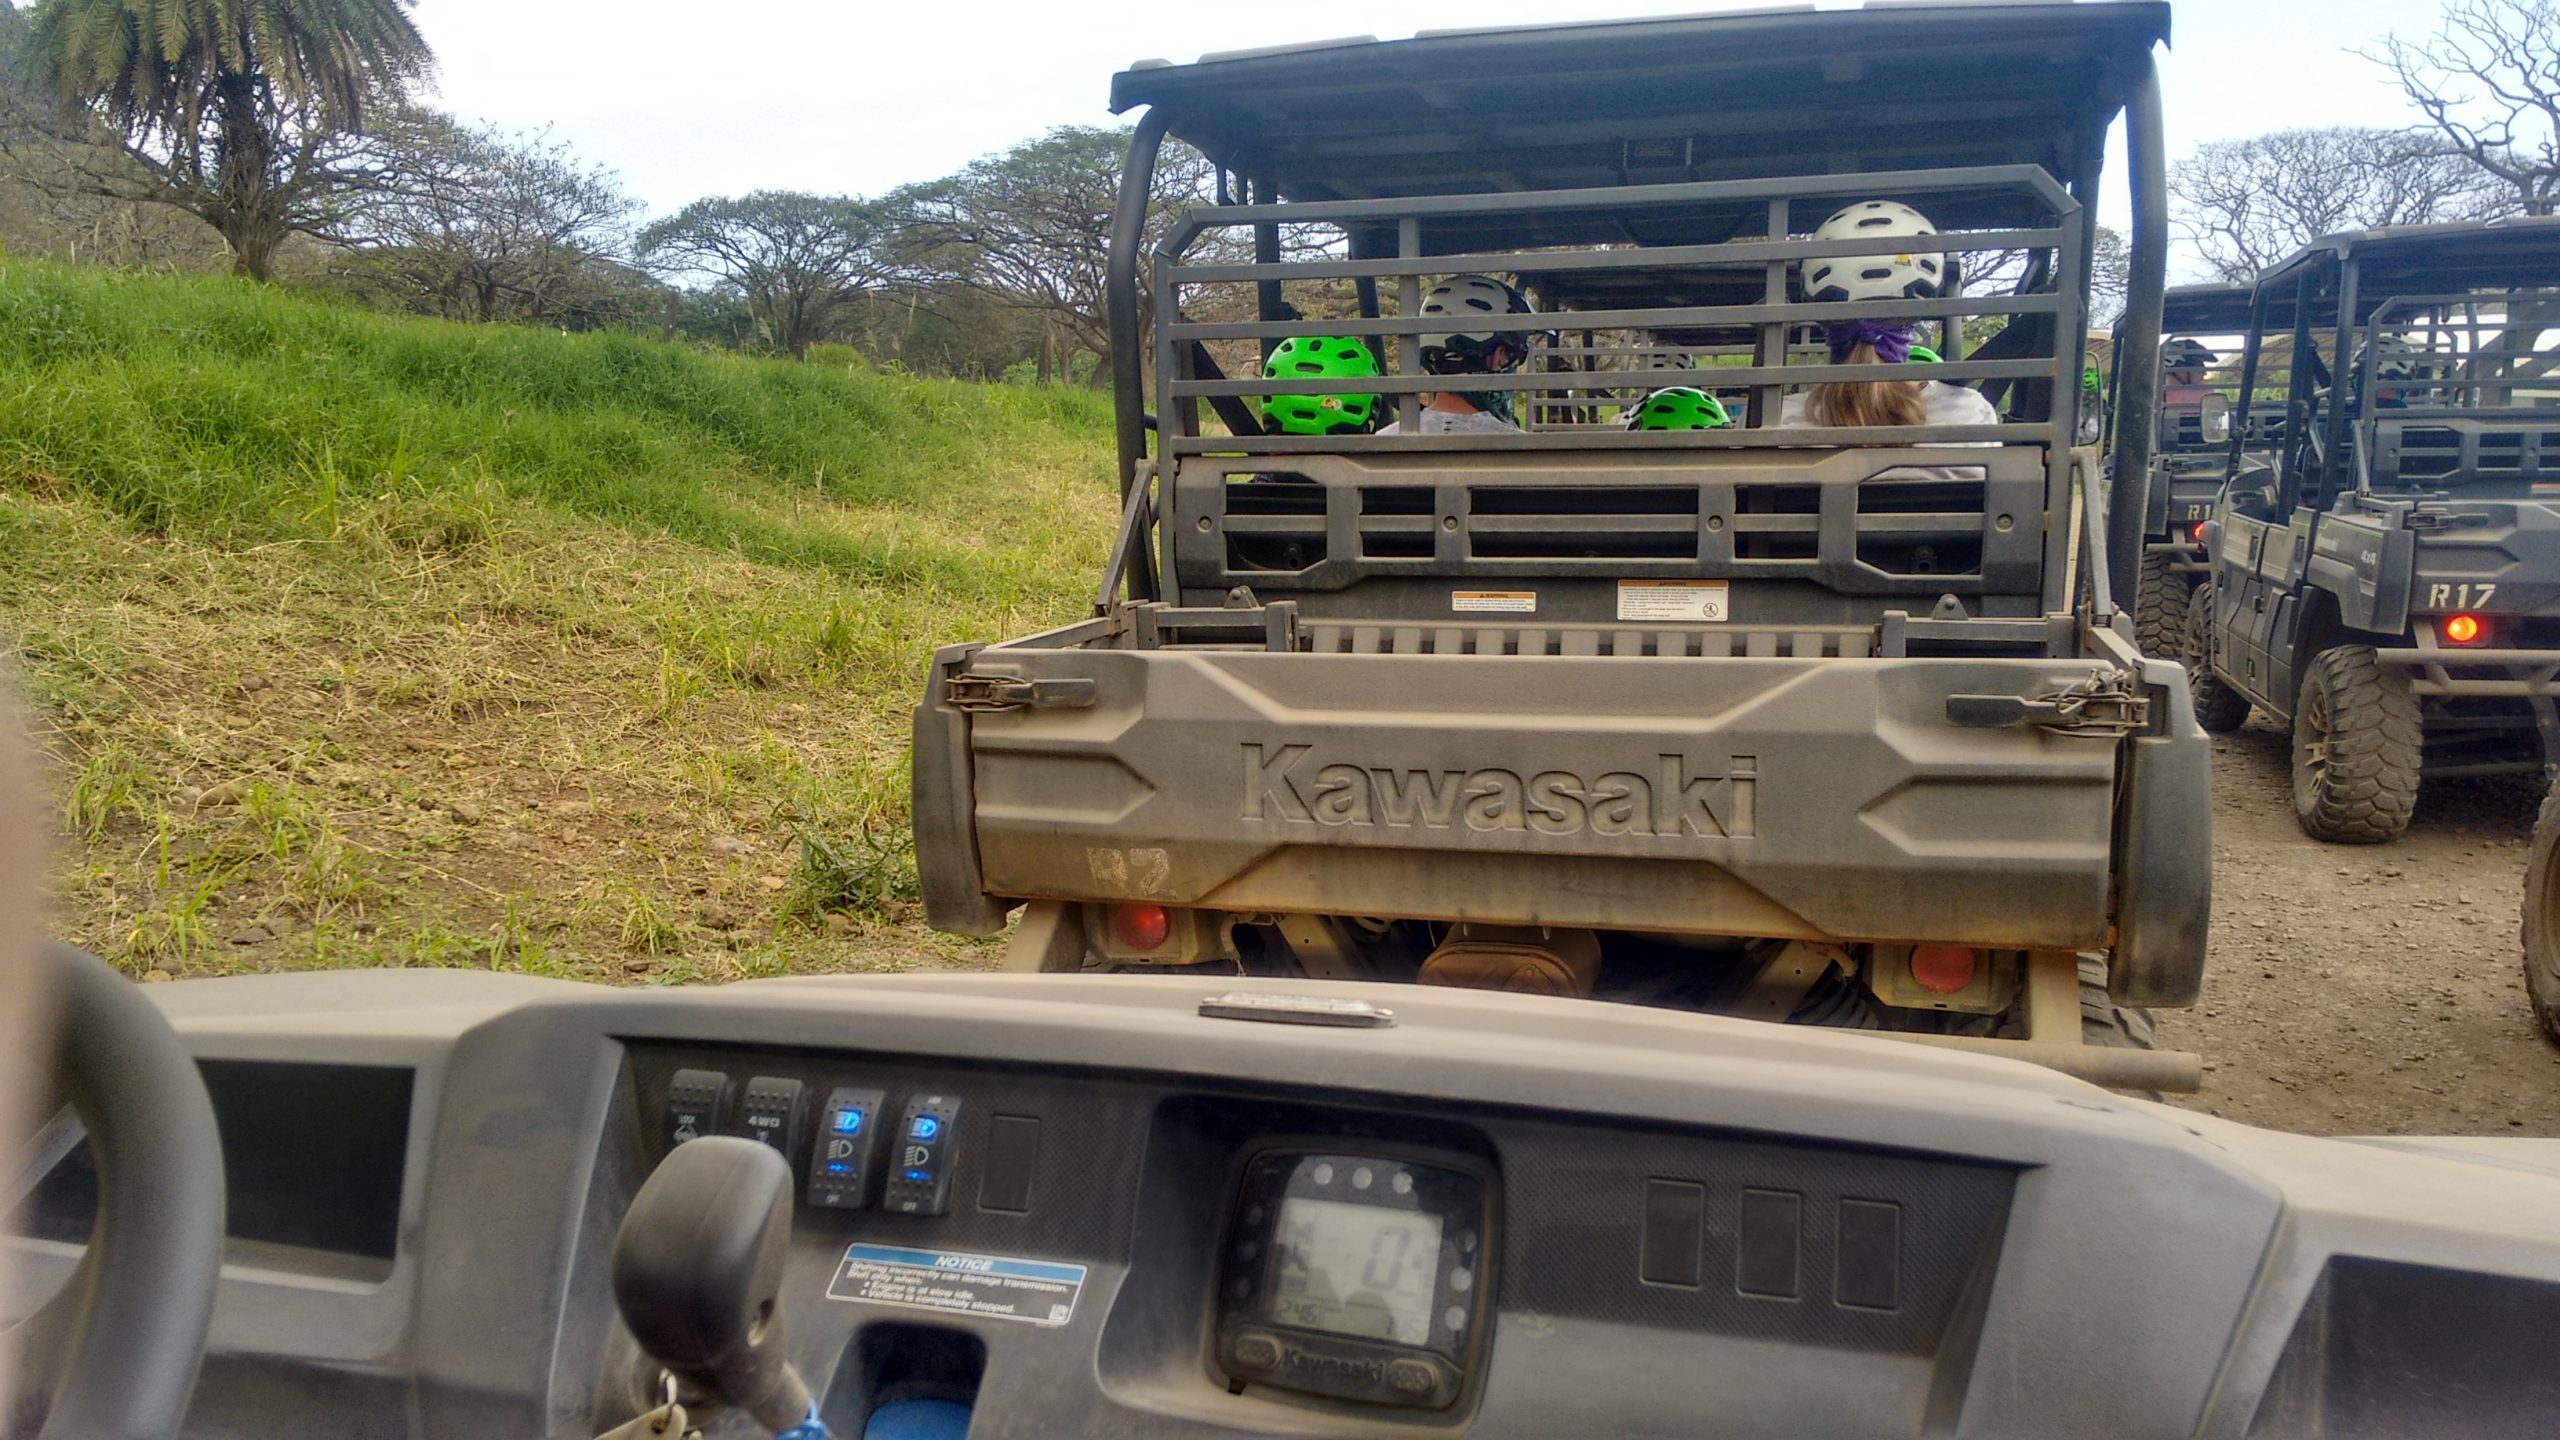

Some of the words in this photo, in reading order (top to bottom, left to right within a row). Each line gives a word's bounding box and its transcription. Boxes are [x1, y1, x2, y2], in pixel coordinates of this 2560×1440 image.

[2428, 583, 2496, 609] R17
[1240, 741, 1759, 840] Kawasaki
[748, 1115, 781, 1129] 4WD
[935, 1255, 995, 1272] NOTICE
